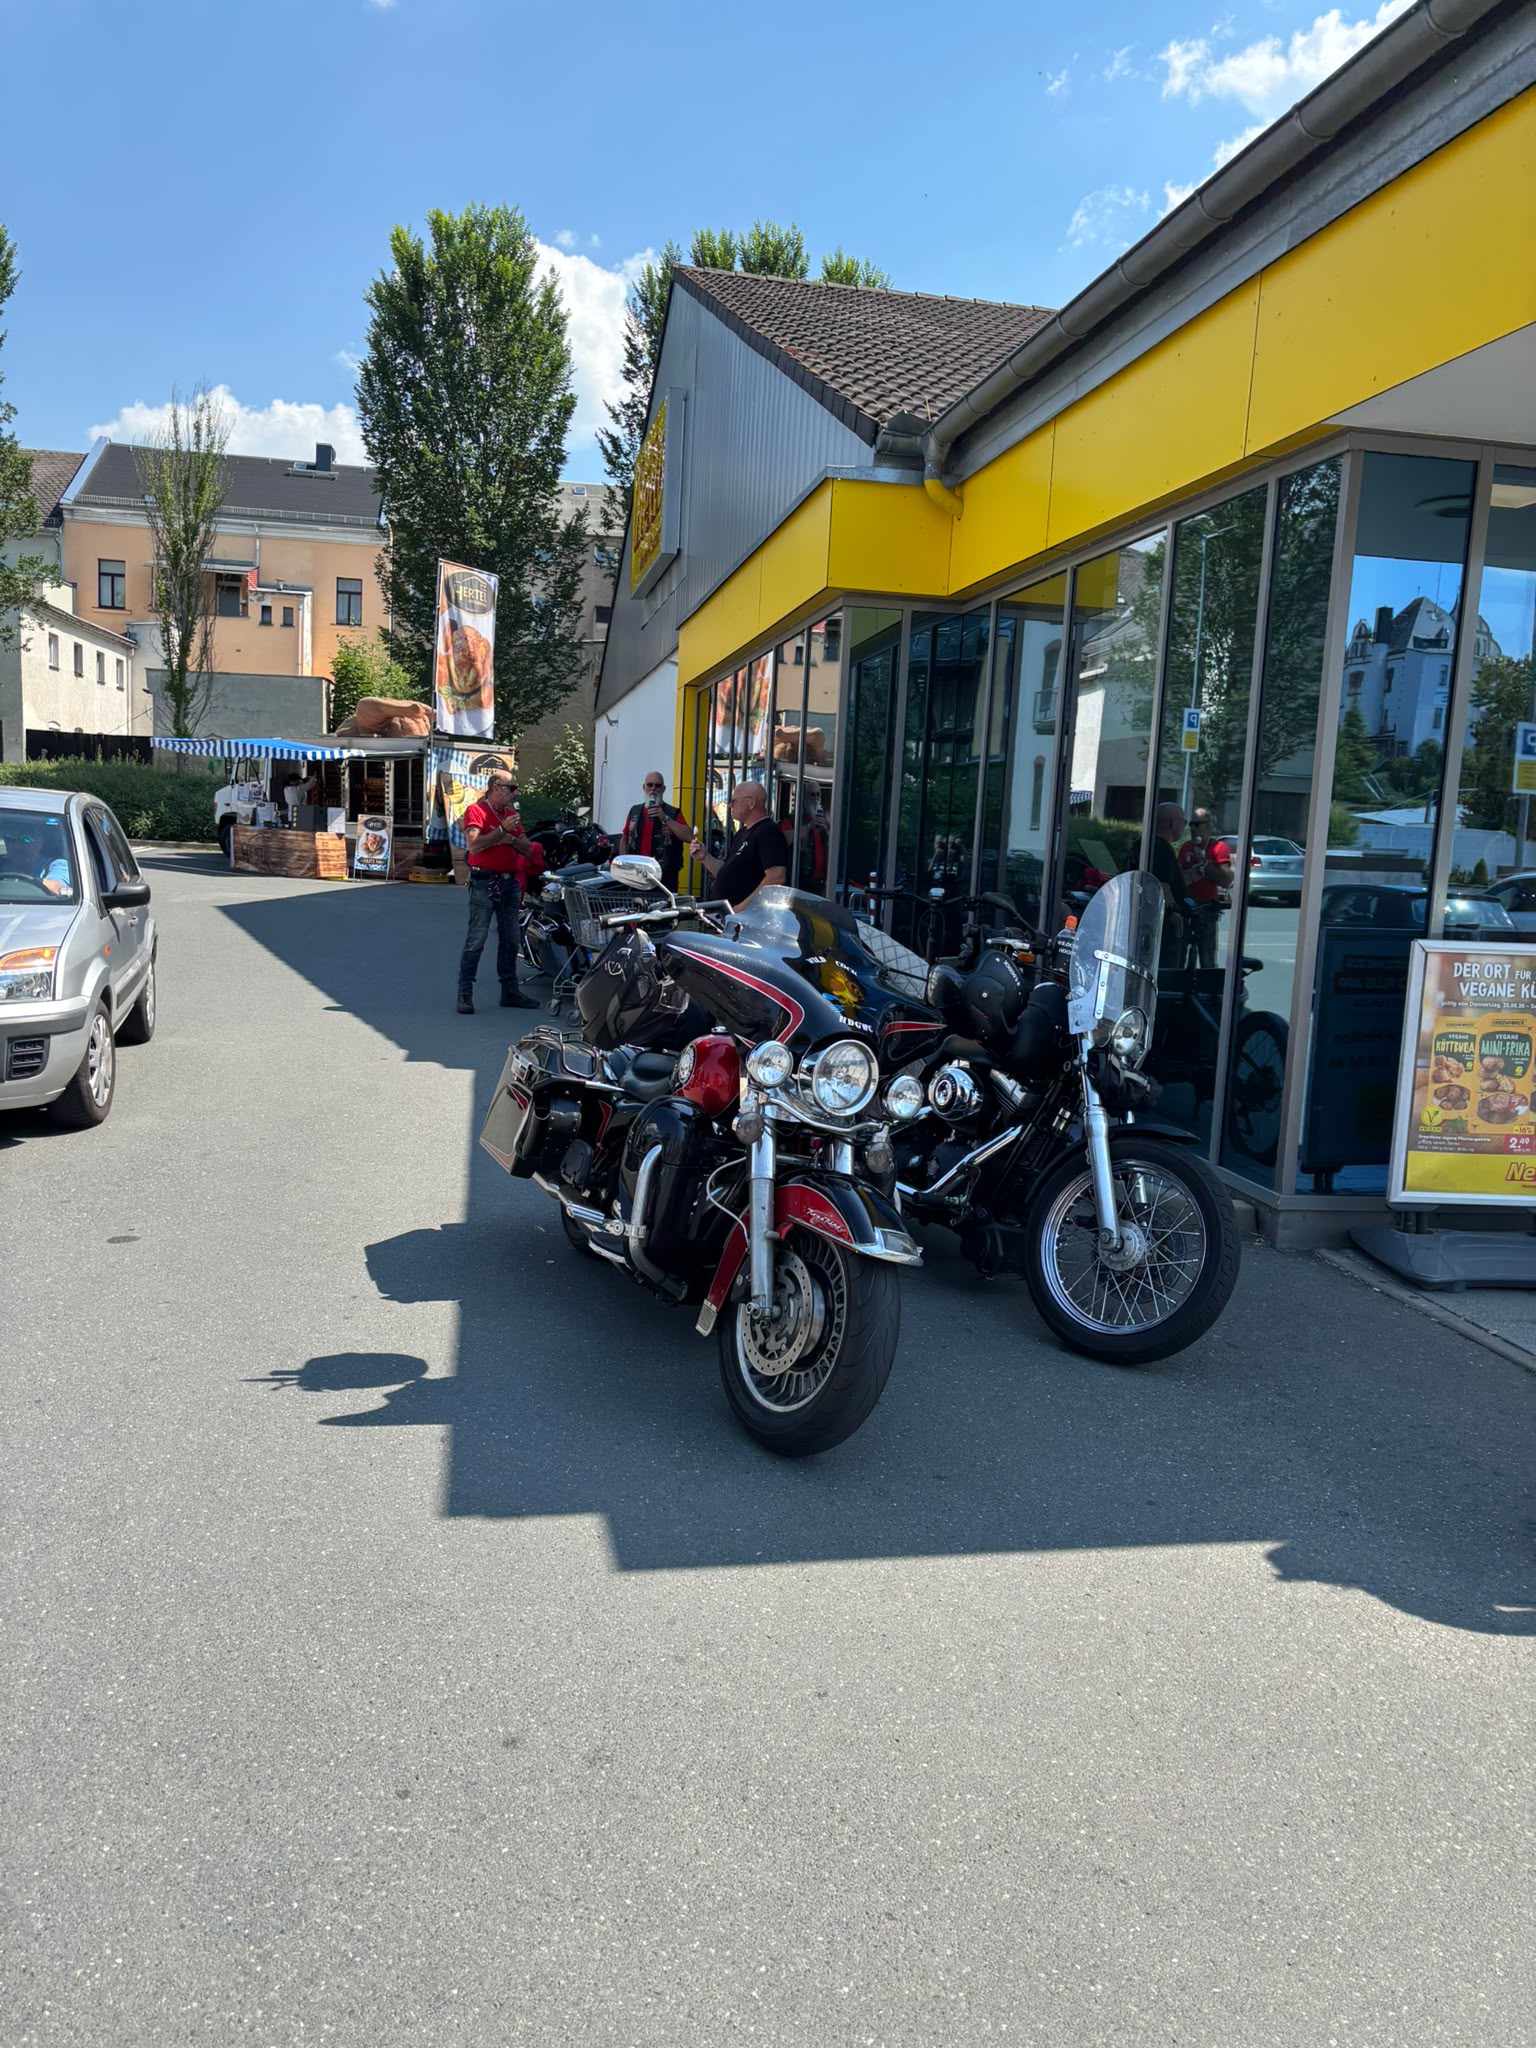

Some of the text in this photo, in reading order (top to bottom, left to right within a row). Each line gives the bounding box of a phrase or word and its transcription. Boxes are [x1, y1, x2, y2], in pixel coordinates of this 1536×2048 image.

[455, 585, 488, 603] HERTEL
[1453, 962, 1480, 978] DER
[1484, 963, 1511, 979] ORT
[1459, 981, 1516, 998] VEGANE
[1481, 1040, 1530, 1057] MINI-FRIKA
